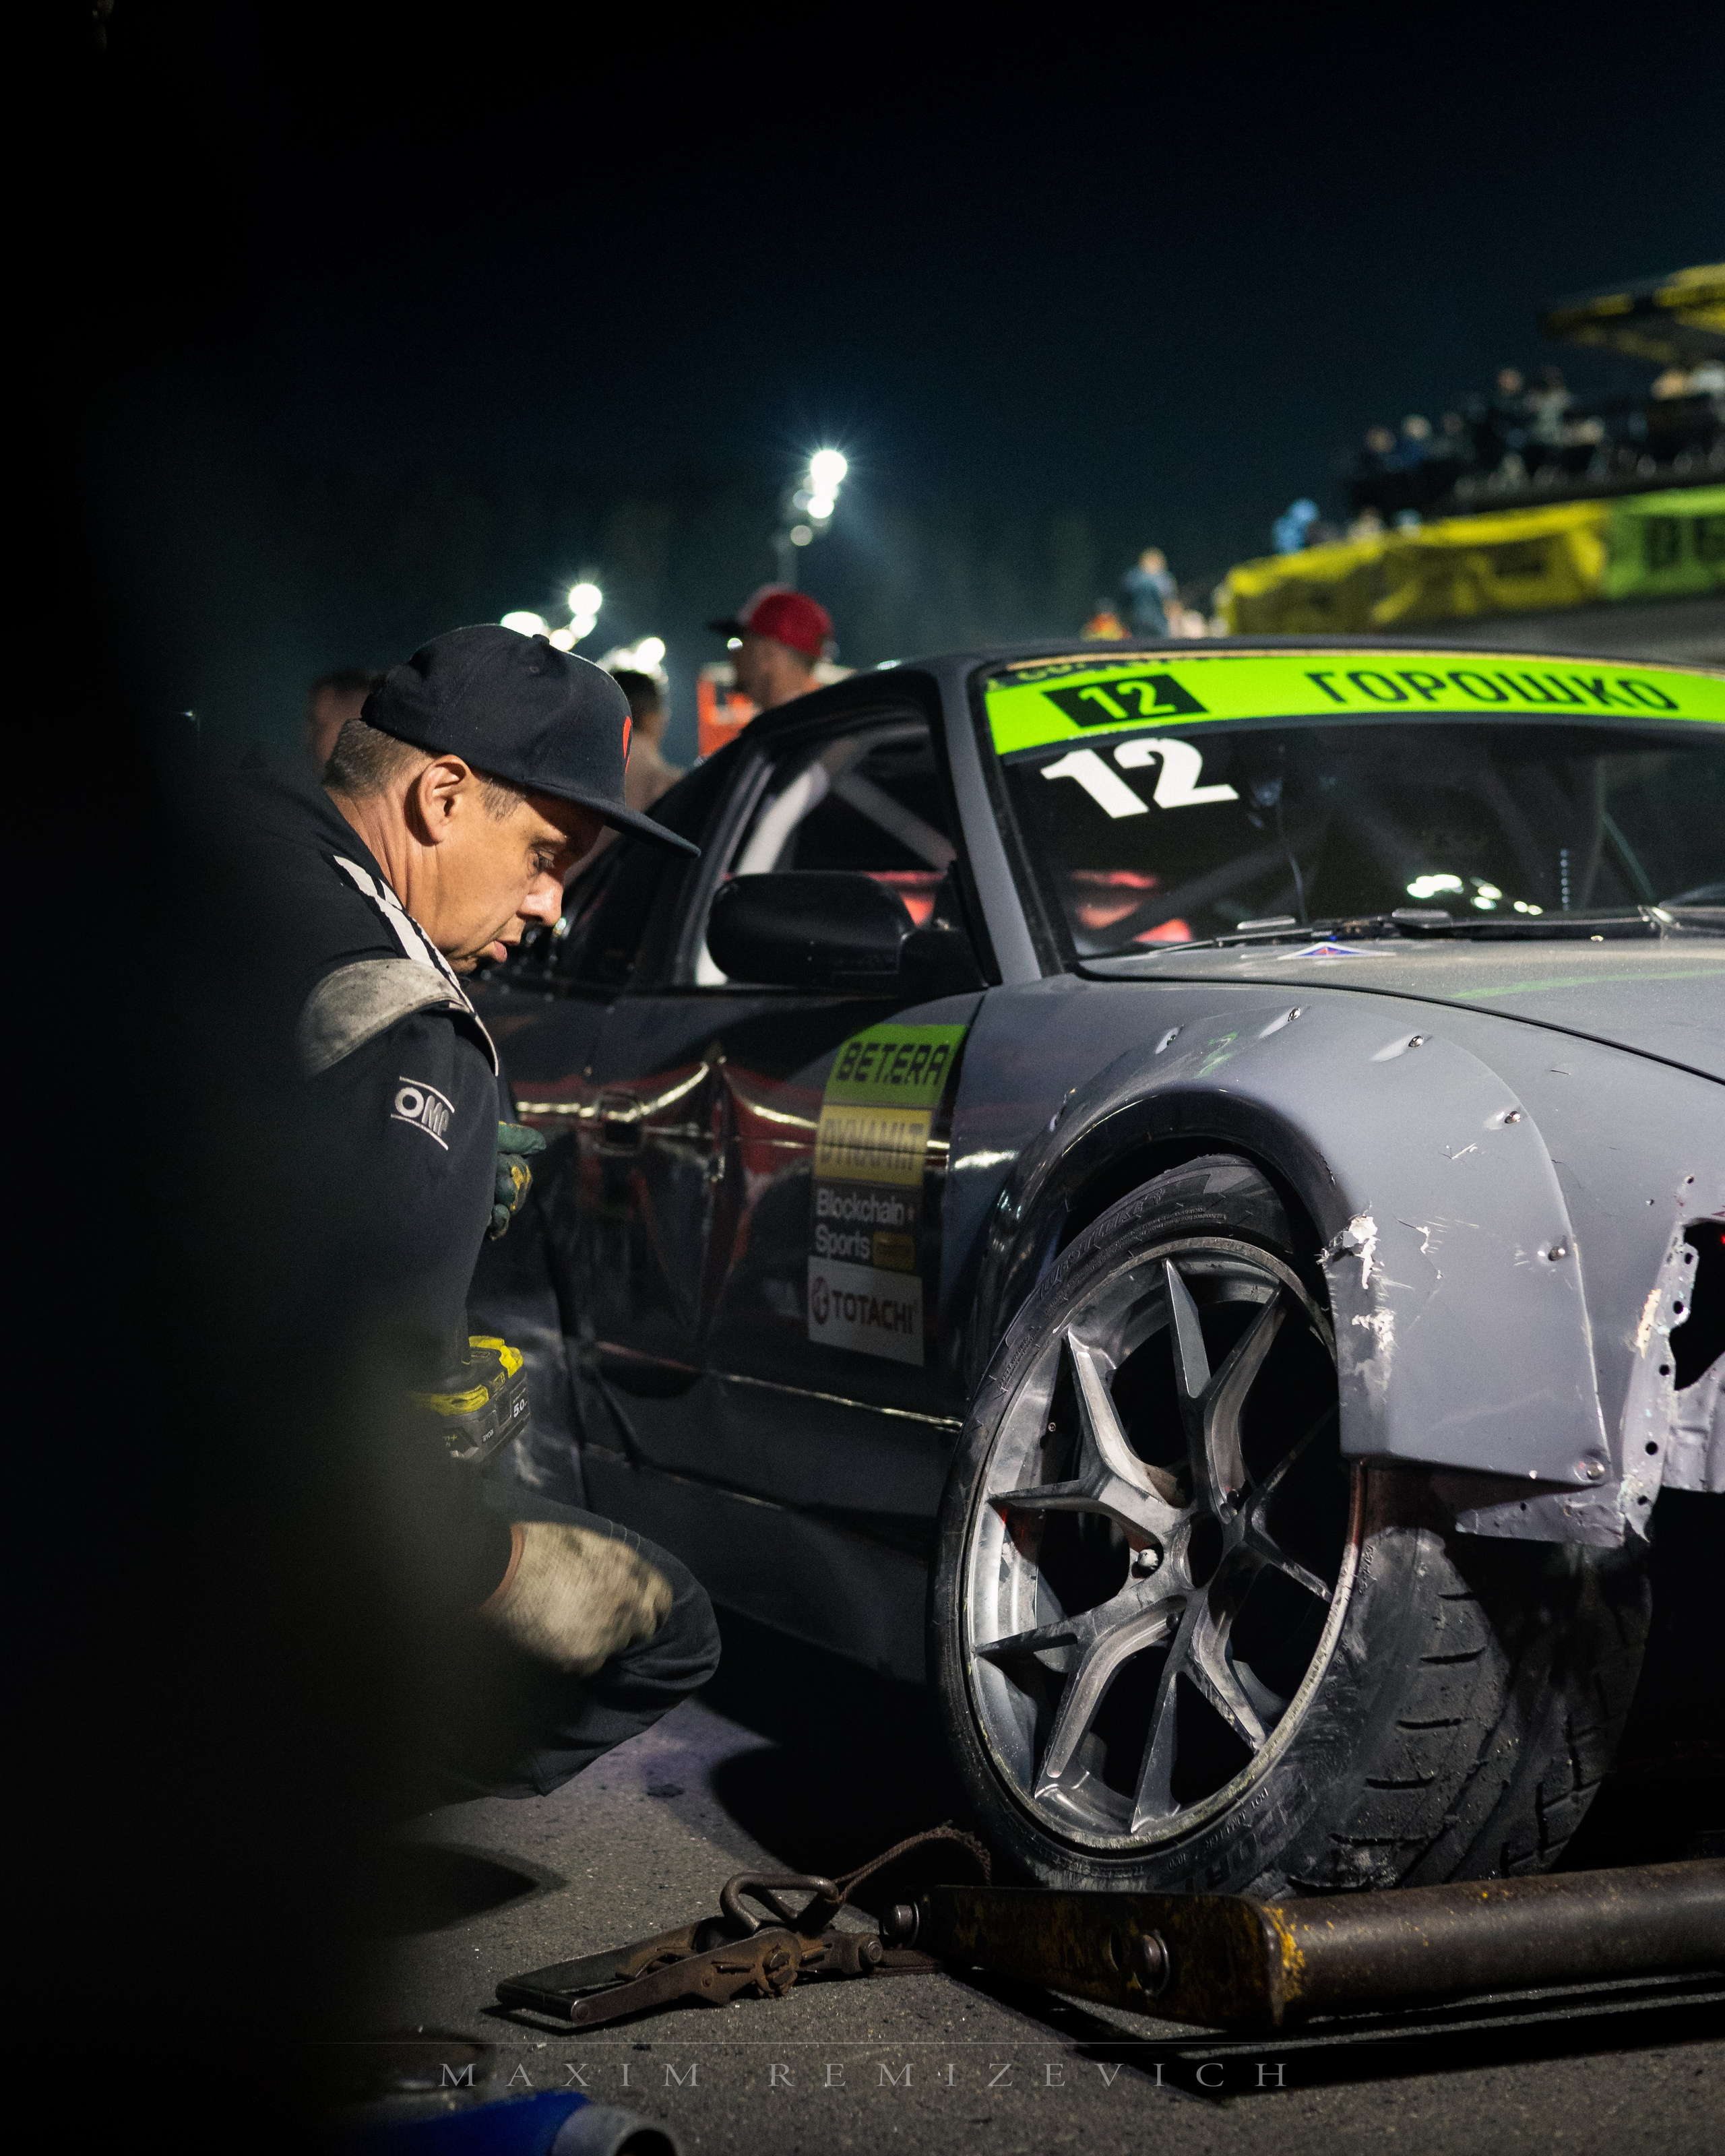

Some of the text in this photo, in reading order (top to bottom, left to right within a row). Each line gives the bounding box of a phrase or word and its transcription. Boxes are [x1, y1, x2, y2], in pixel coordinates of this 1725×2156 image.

[1079, 670, 1679, 720] 12 ГОРОШКО
[1040, 737, 1240, 819] 12
[395, 1087, 449, 1138] OMP
[815, 1223, 871, 1260] Sports
[832, 1289, 912, 1335] TOTACHI
